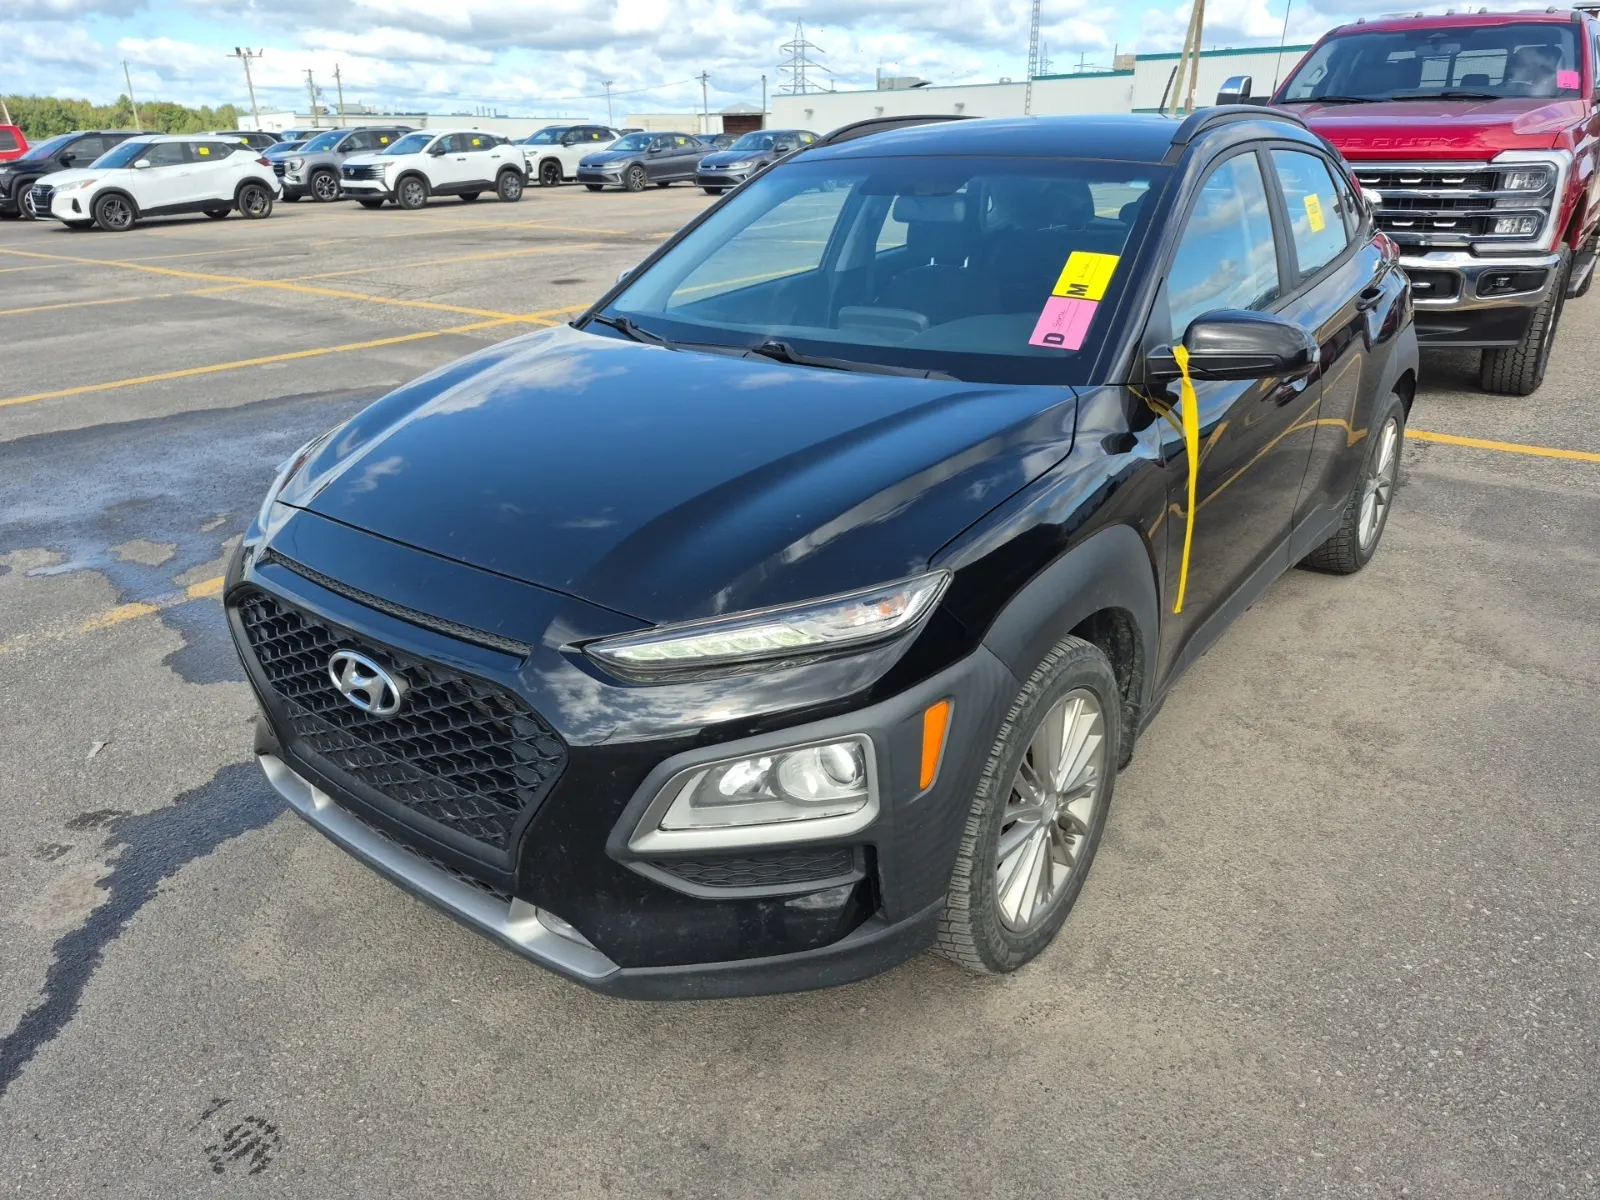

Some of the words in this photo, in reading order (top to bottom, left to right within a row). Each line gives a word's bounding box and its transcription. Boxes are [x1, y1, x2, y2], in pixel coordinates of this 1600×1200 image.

[1371, 138, 1461, 147] DUTY
[1066, 283, 1089, 296] M
[1042, 332, 1065, 345] D
